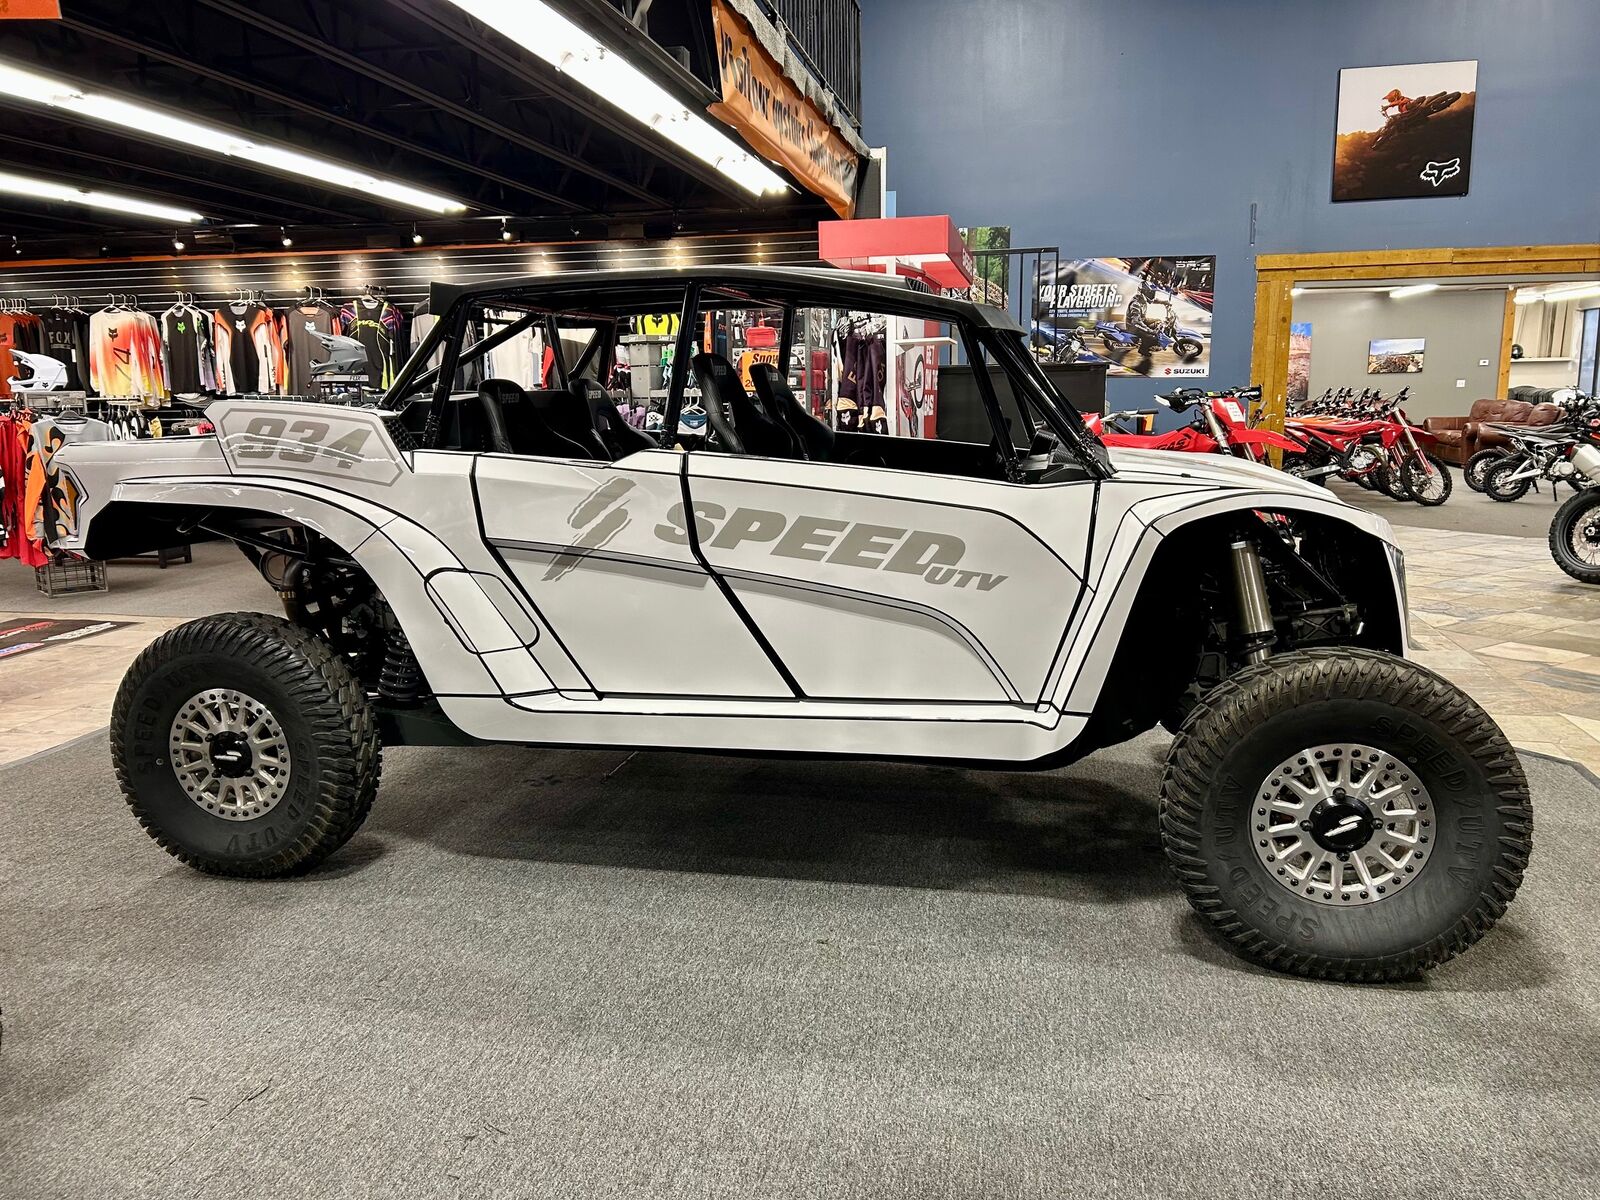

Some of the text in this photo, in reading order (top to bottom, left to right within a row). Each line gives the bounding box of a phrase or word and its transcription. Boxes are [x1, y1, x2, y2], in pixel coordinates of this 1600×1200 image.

[1068, 283, 1119, 298] STREETS
[48, 331, 71, 344] FOX
[237, 417, 373, 470] 934
[654, 500, 967, 576] SPEED
[923, 565, 1008, 591] UTV
